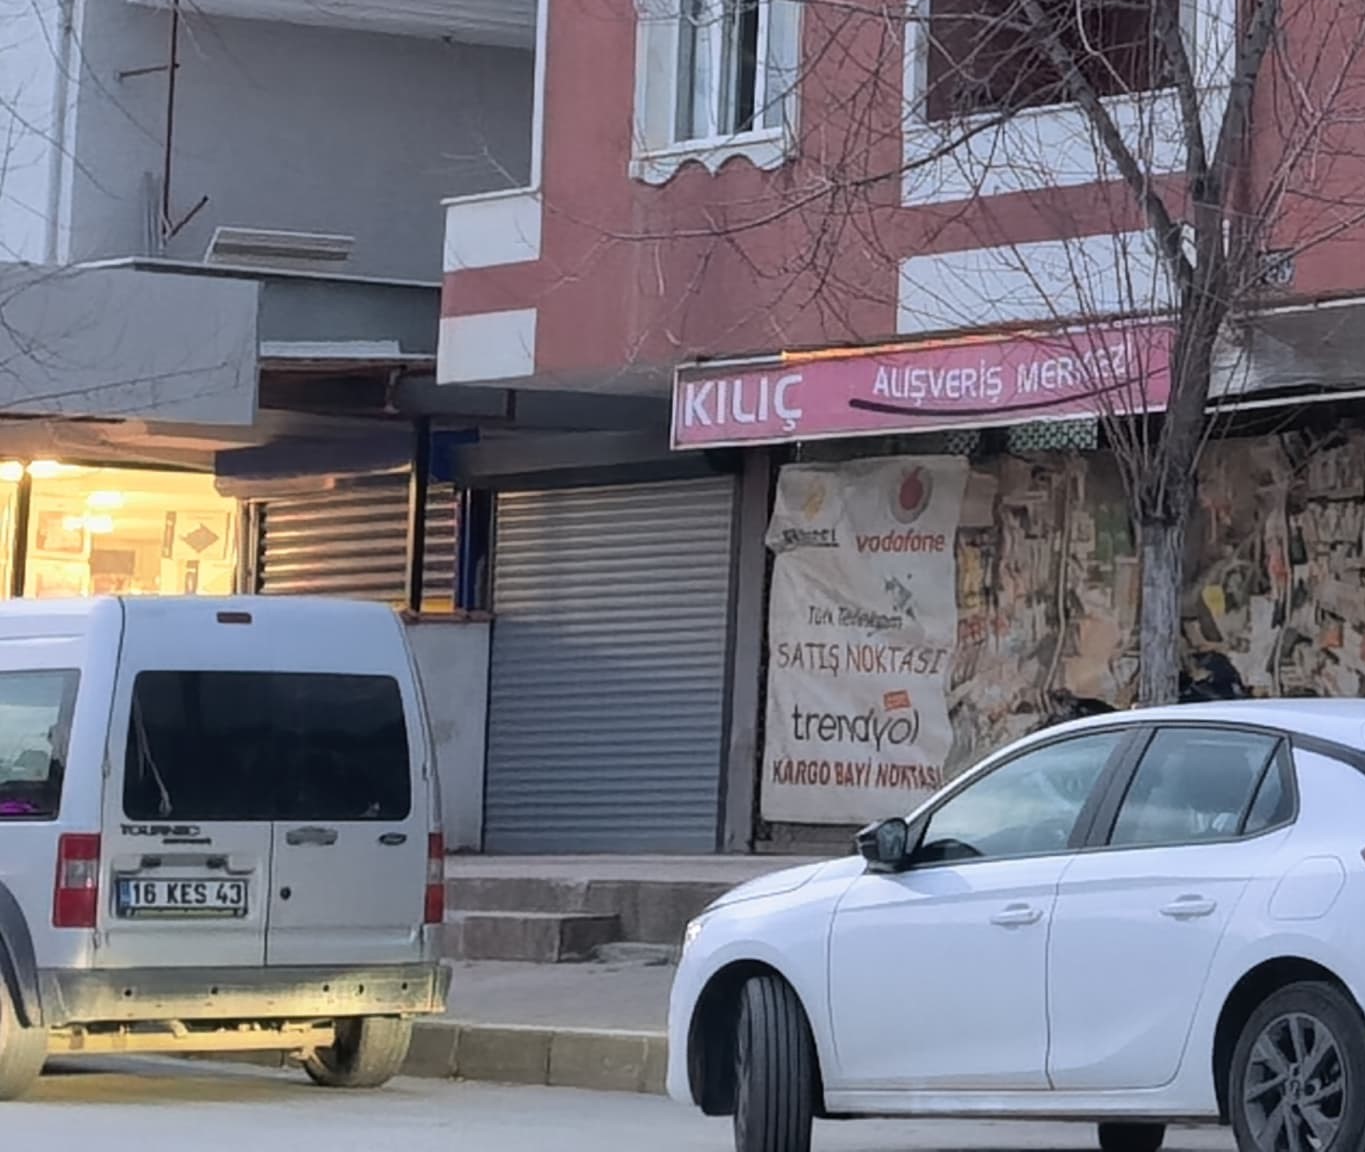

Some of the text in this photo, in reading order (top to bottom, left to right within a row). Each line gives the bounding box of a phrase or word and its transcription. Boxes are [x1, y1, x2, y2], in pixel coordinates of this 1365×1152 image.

[683, 374, 803, 432] KILIÇ
[872, 366, 1002, 404] ALIŞVERİŞ
[856, 528, 946, 553] vodafone
[777, 642, 948, 677] SATIŞ NOKTASI
[792, 703, 920, 752] trendyol
[772, 759, 831, 786] KARGO
[132, 883, 242, 905] 16 KES 43
